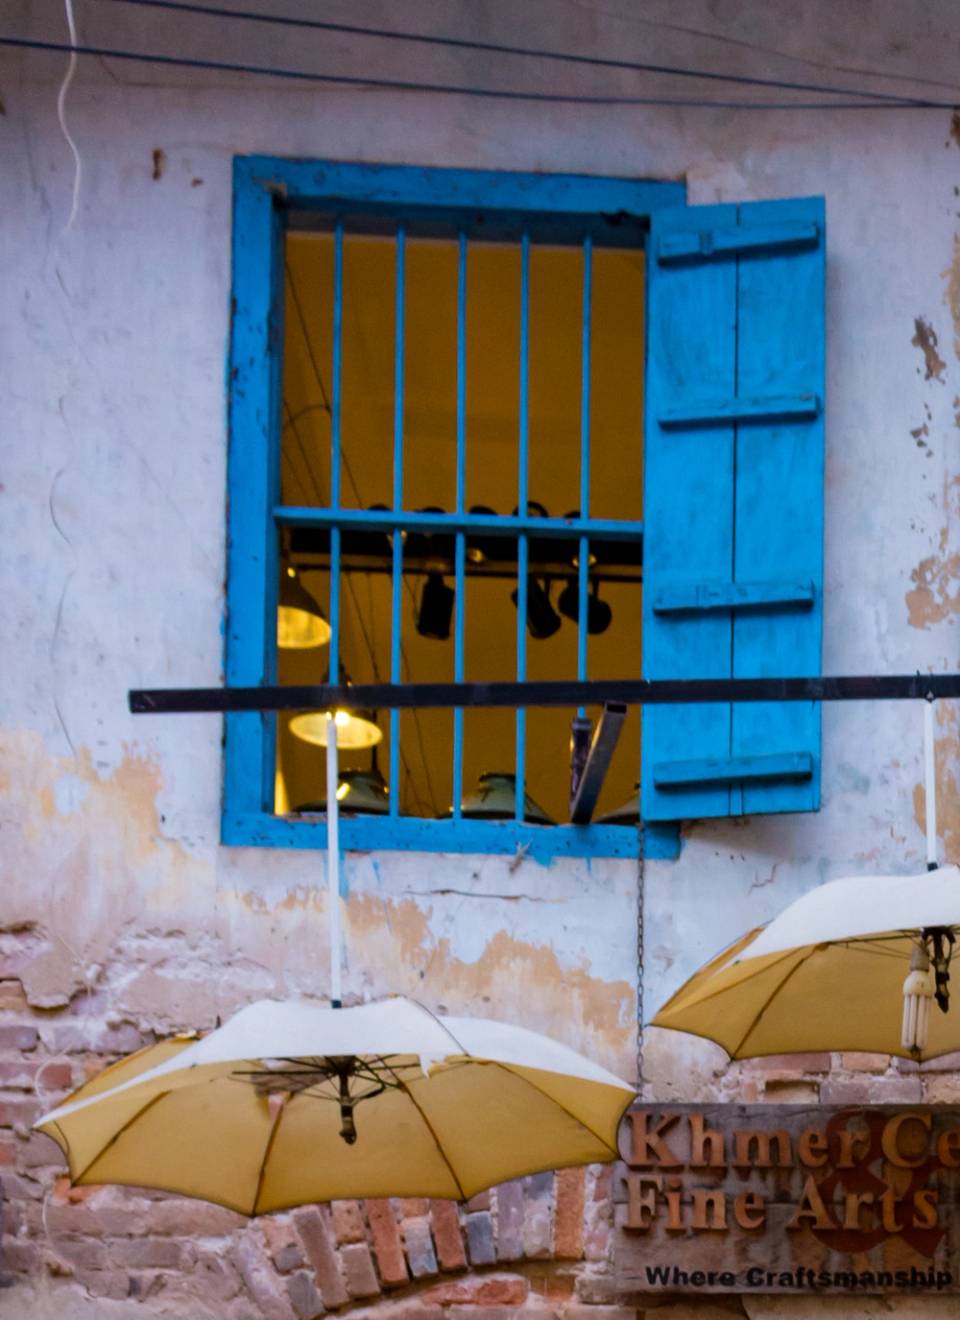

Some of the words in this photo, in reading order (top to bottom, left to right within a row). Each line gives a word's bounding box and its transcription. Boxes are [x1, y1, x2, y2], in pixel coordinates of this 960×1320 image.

[625, 1111, 872, 1169] Khmer
[621, 1174, 767, 1230] Fine
[789, 1174, 939, 1232] Arts
[645, 1265, 735, 1287] Where
[746, 1265, 952, 1288] Craftsmanship
